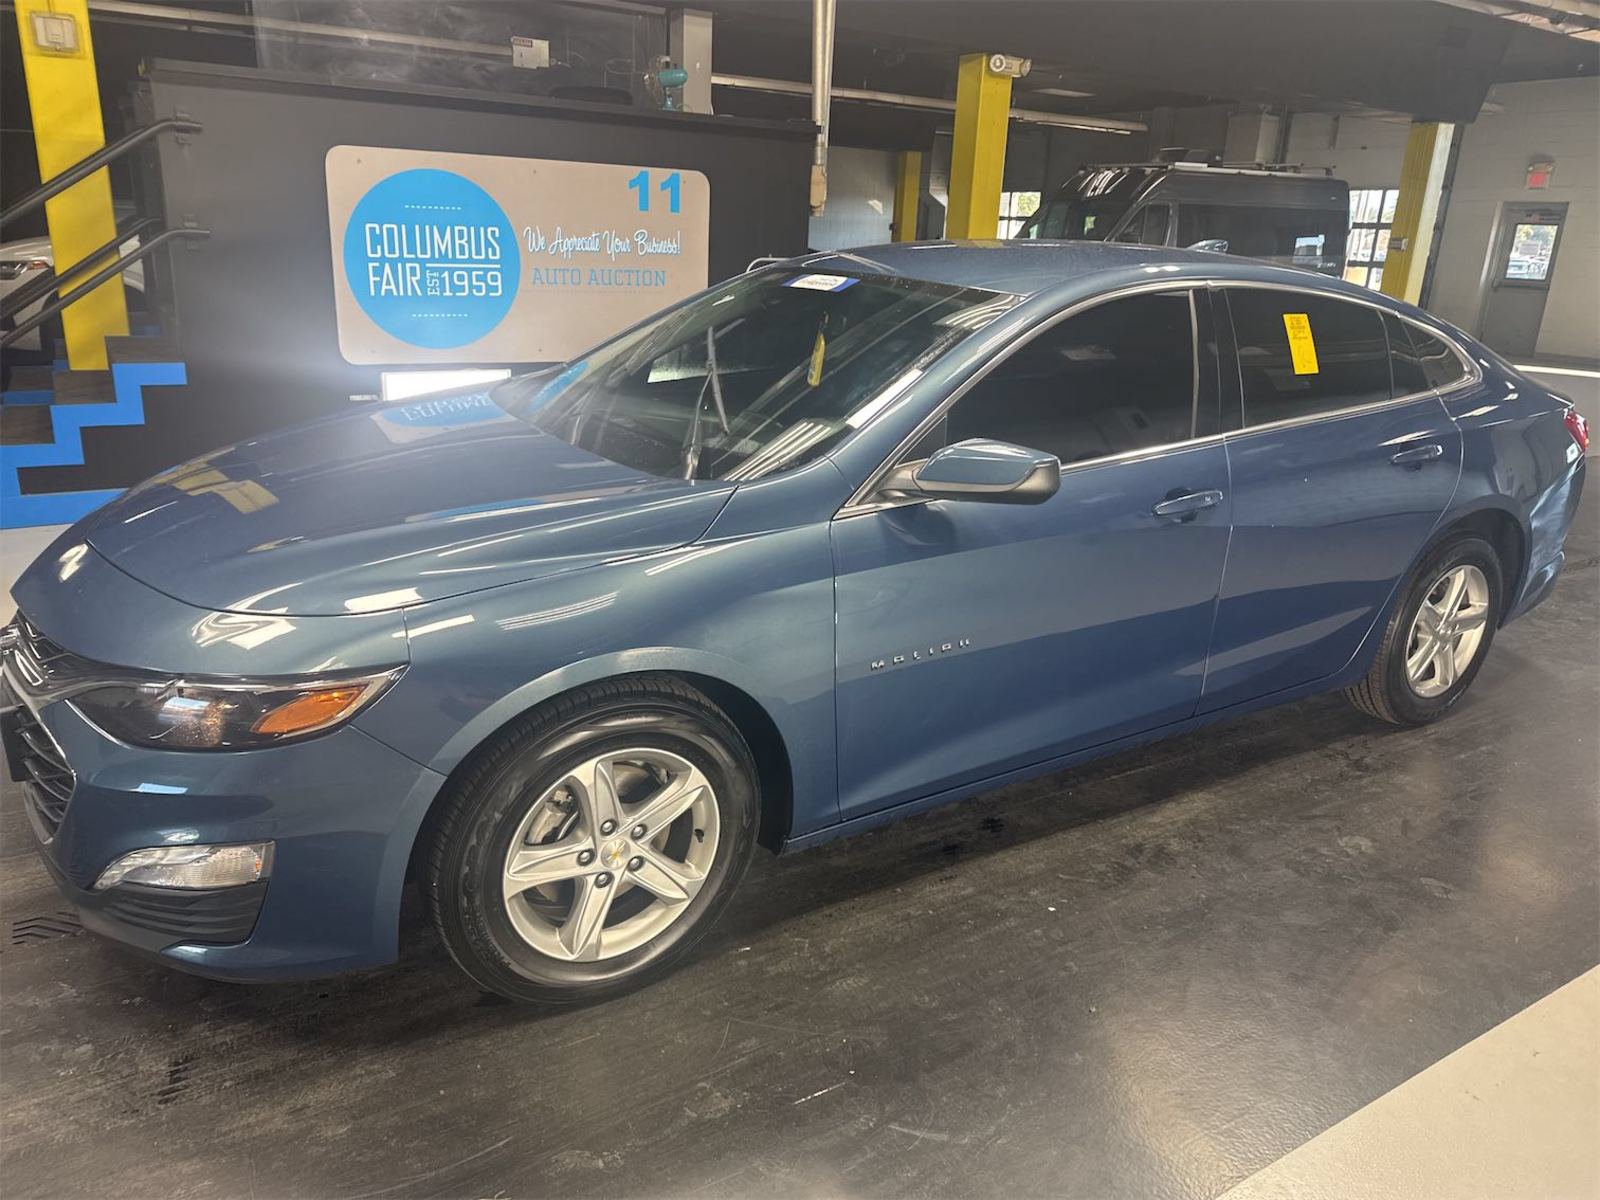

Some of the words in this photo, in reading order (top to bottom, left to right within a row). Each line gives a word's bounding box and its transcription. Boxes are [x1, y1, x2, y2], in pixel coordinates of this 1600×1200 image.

[628, 170, 681, 214] 11
[365, 223, 501, 260] COLUMBUS
[523, 226, 546, 252] We
[549, 226, 601, 260] Appreciate
[602, 229, 632, 262] Your
[634, 229, 681, 256] Business!
[368, 262, 422, 297] FAIR
[426, 269, 440, 296] EST
[441, 270, 502, 297] 1959
[532, 267, 582, 286] AUTO
[588, 268, 667, 287] AUCTION
